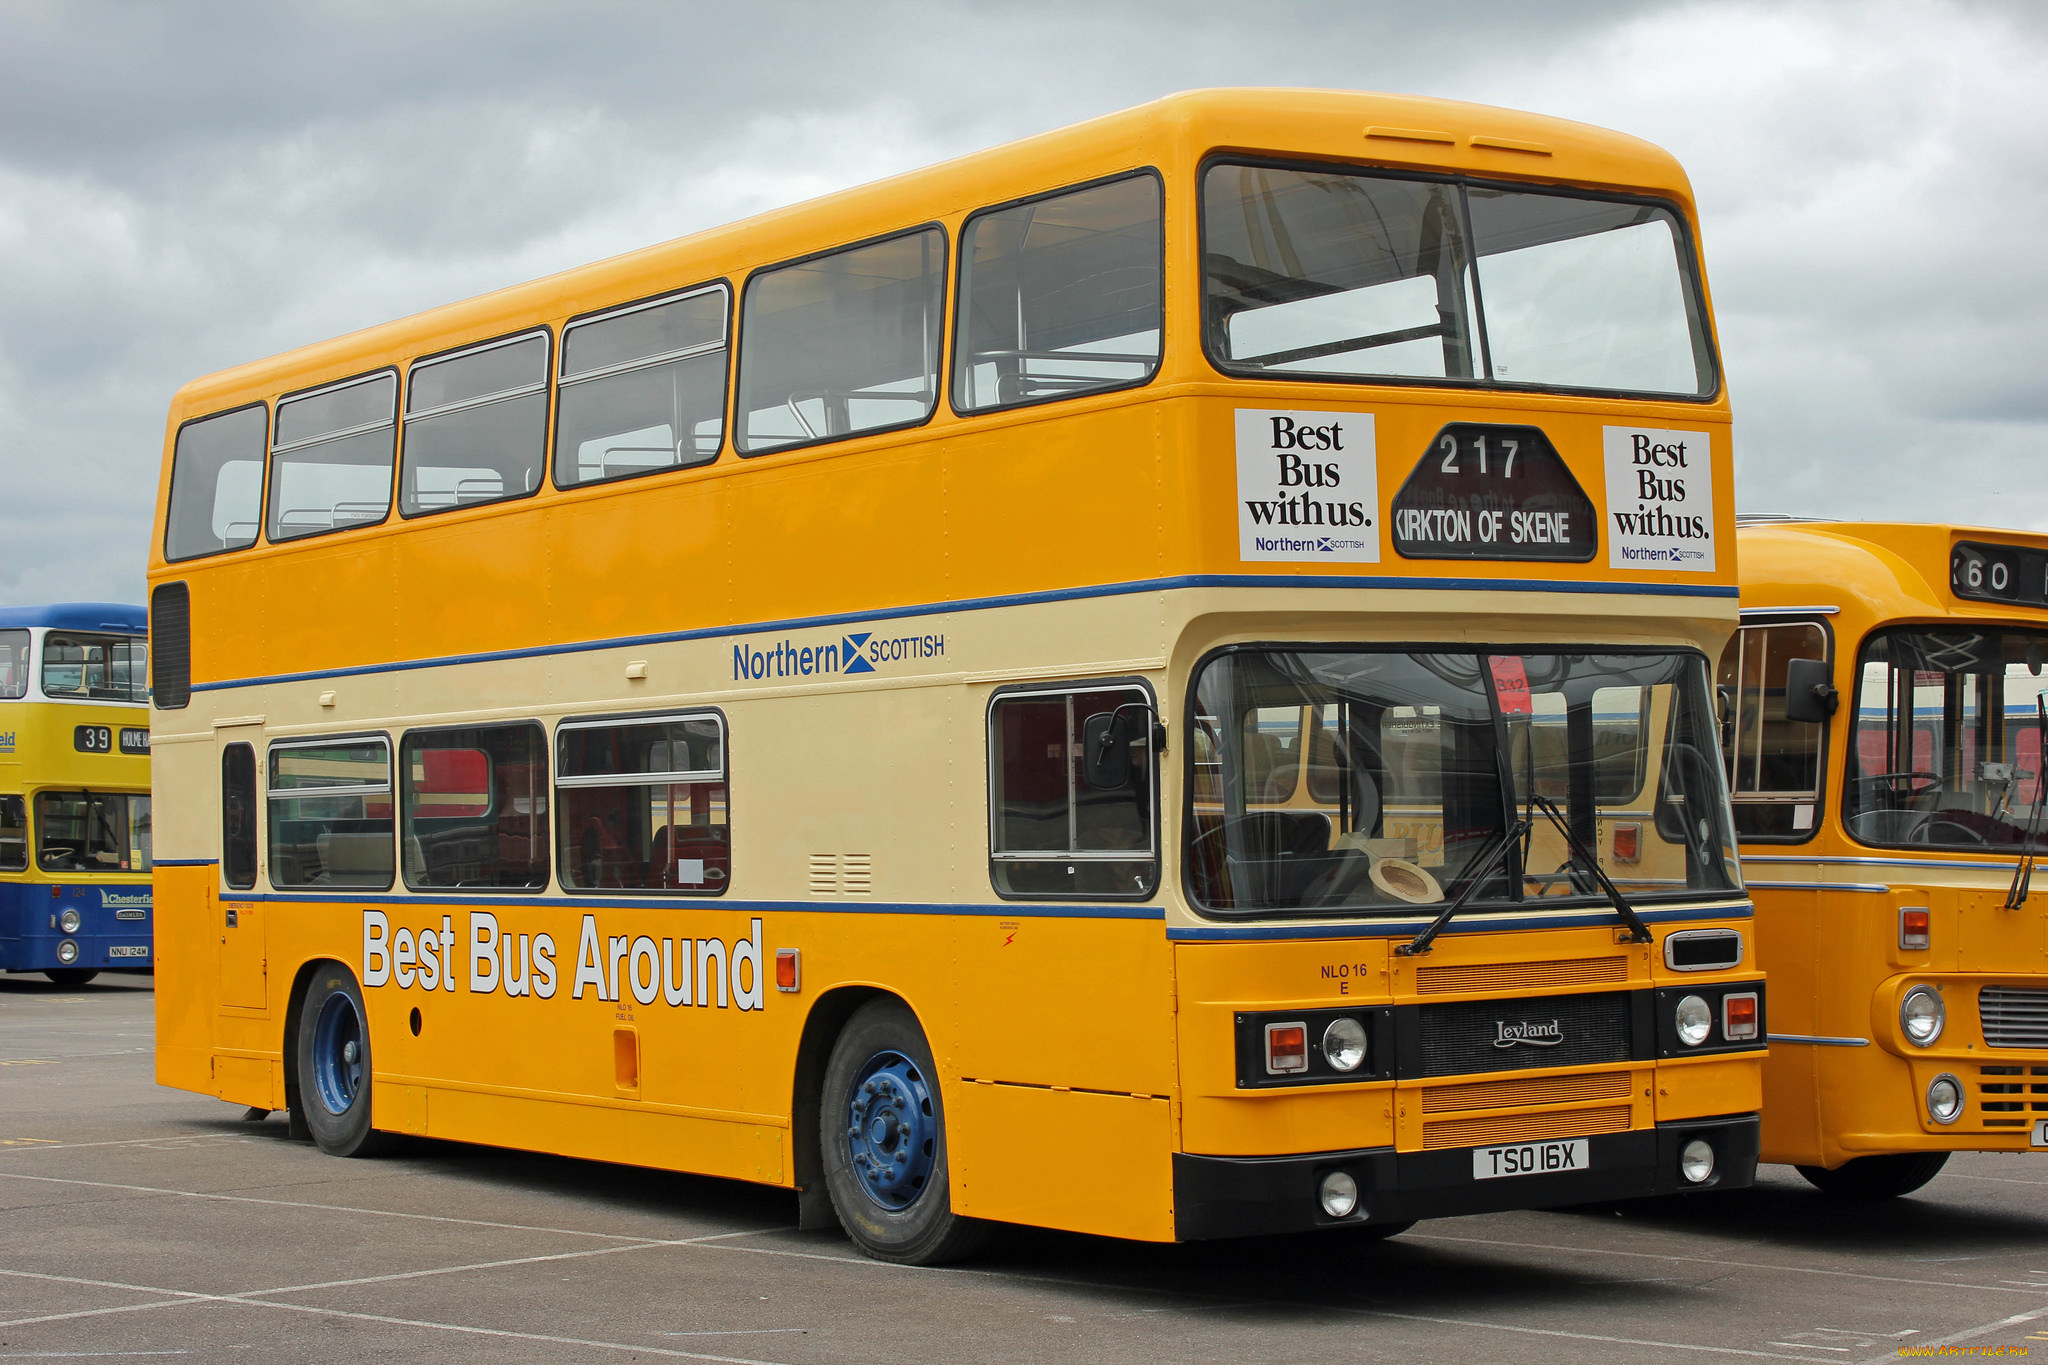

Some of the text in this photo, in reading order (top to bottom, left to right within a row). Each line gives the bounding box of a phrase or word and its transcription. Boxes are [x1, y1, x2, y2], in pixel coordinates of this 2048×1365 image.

[1269, 416, 1344, 451] Best
[1440, 434, 1518, 478] 217
[1631, 434, 1688, 468] Best
[1276, 453, 1340, 488] Bus
[1636, 469, 1686, 502] Bus
[1245, 491, 1325, 526] with
[1613, 504, 1675, 537] with
[1478, 510, 1503, 543] OF
[1511, 511, 1570, 543] SKENE
[1256, 537, 1364, 552] Northern SCOTTISH
[1622, 546, 1704, 561] Northern SCOTTISH
[733, 634, 944, 681] Northern SCOTTISH
[1496, 678, 1526, 693] B32
[86, 728, 108, 749] 39
[123, 731, 142, 748] HOLME
[111, 947, 128, 956] NNU
[363, 909, 764, 1011] Best Bus Around
[1321, 963, 1367, 979] NLO 16
[1341, 981, 1349, 995] E
[1493, 1019, 1563, 1047] Leyland
[1488, 1143, 1575, 1175] TSO 16X
